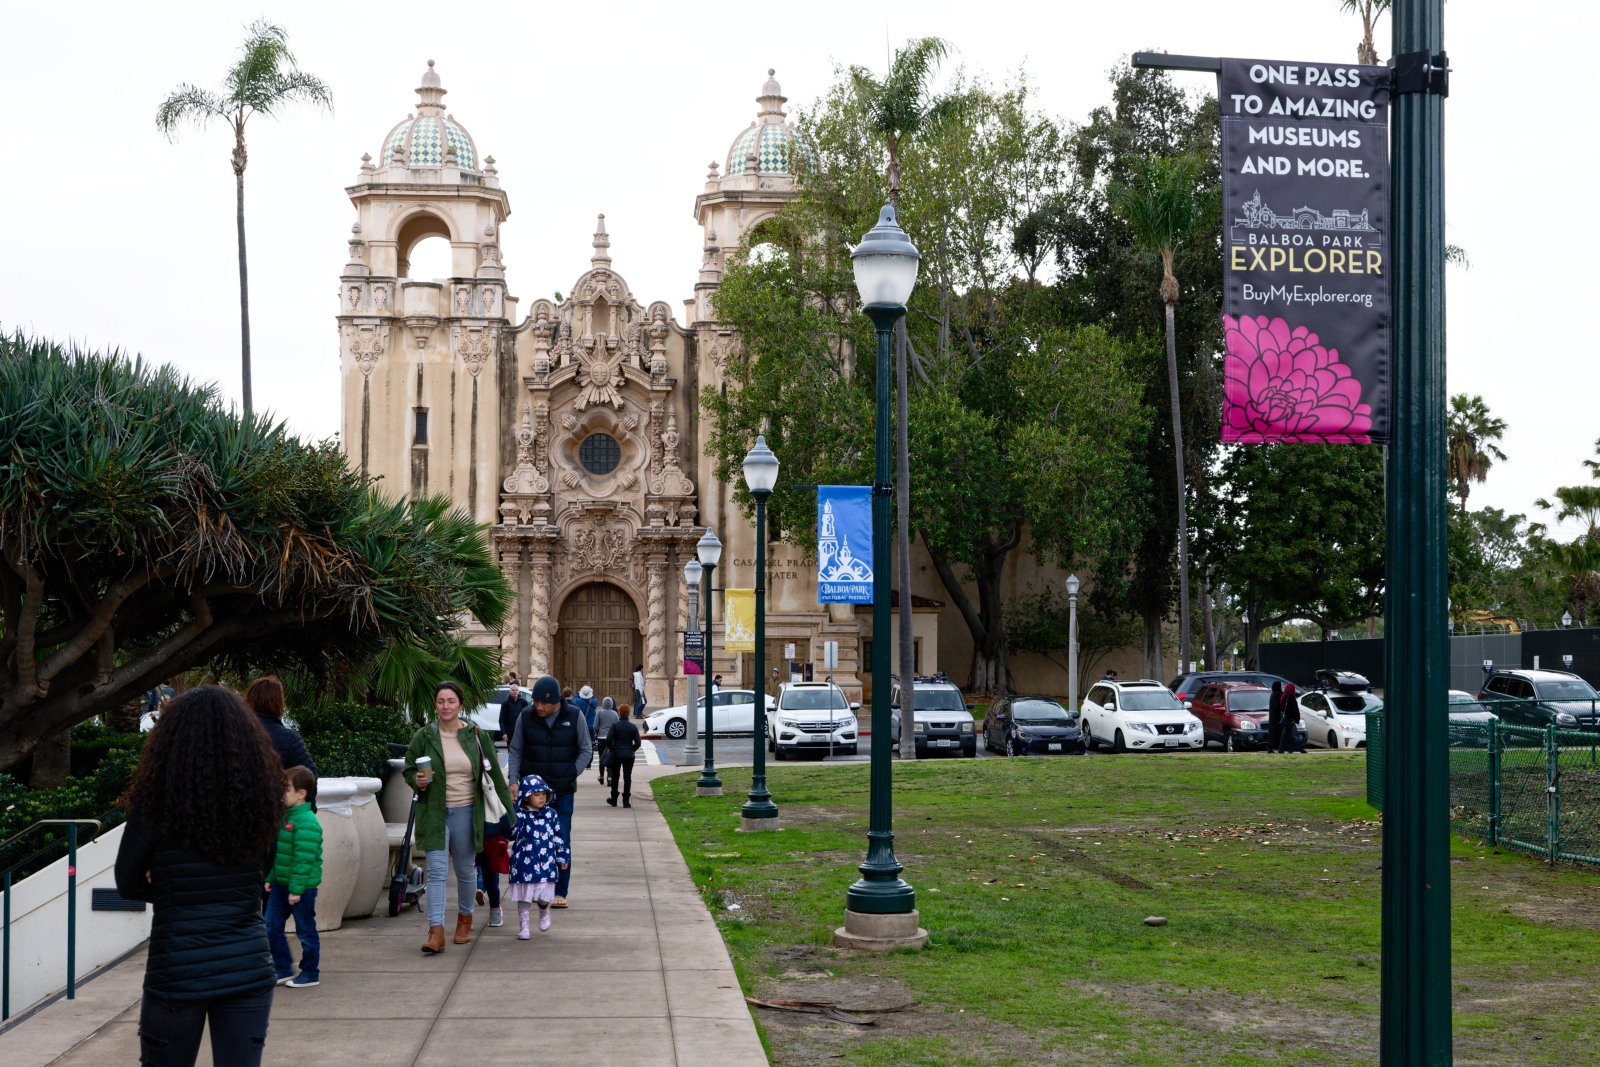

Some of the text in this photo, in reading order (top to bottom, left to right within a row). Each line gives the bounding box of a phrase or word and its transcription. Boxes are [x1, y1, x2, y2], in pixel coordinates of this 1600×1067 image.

[1249, 64, 1361, 88] ONE PASS
[1231, 94, 1377, 119] TO AMAZING
[1248, 125, 1361, 148] MUSEUMS
[1240, 155, 1370, 178] AND MORE.
[1249, 233, 1363, 248] BALBOA PARK
[1231, 246, 1382, 275] EXPLORER
[1243, 284, 1373, 307] BuyMyExplorer.org
[821, 583, 871, 596] BALBOA PARK
